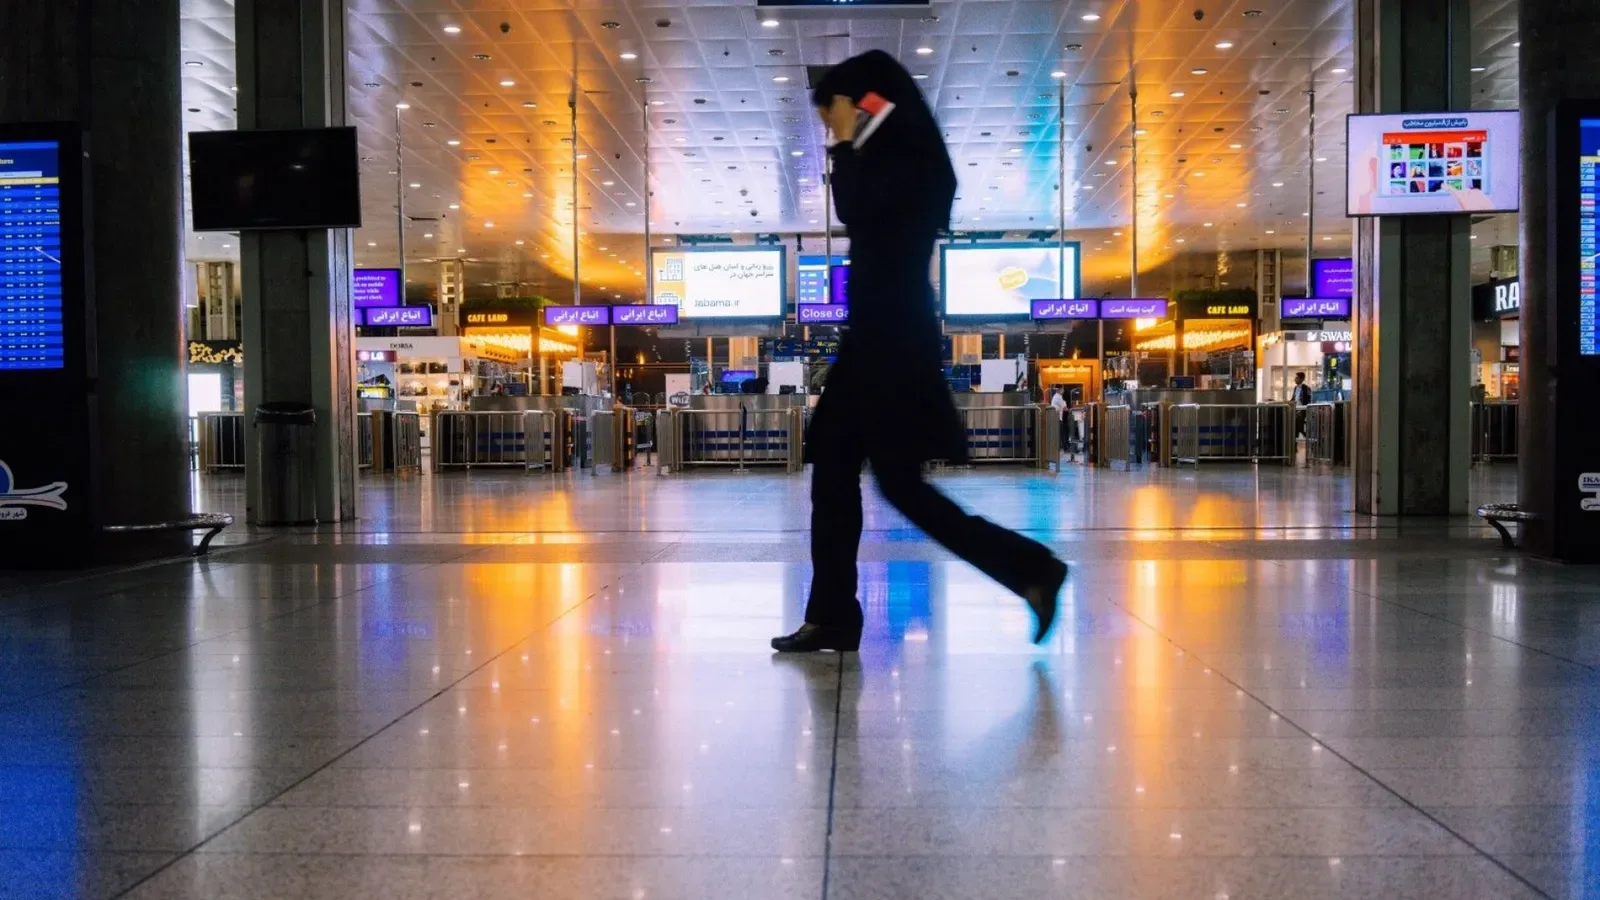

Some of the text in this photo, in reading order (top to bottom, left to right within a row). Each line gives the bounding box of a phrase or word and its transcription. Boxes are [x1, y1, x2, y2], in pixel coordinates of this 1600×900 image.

[802, 308, 832, 318] Close
[1039, 303, 1089, 316] اتباع ایرانی
[1207, 306, 1249, 315] CAFE LAND
[1289, 302, 1317, 315] ایرانی
[373, 310, 399, 323] ایرانی
[467, 314, 508, 322] CAFE LAND
[553, 311, 578, 322] ایرانی
[620, 310, 645, 321] ایرانی
[371, 351, 384, 361] LG
